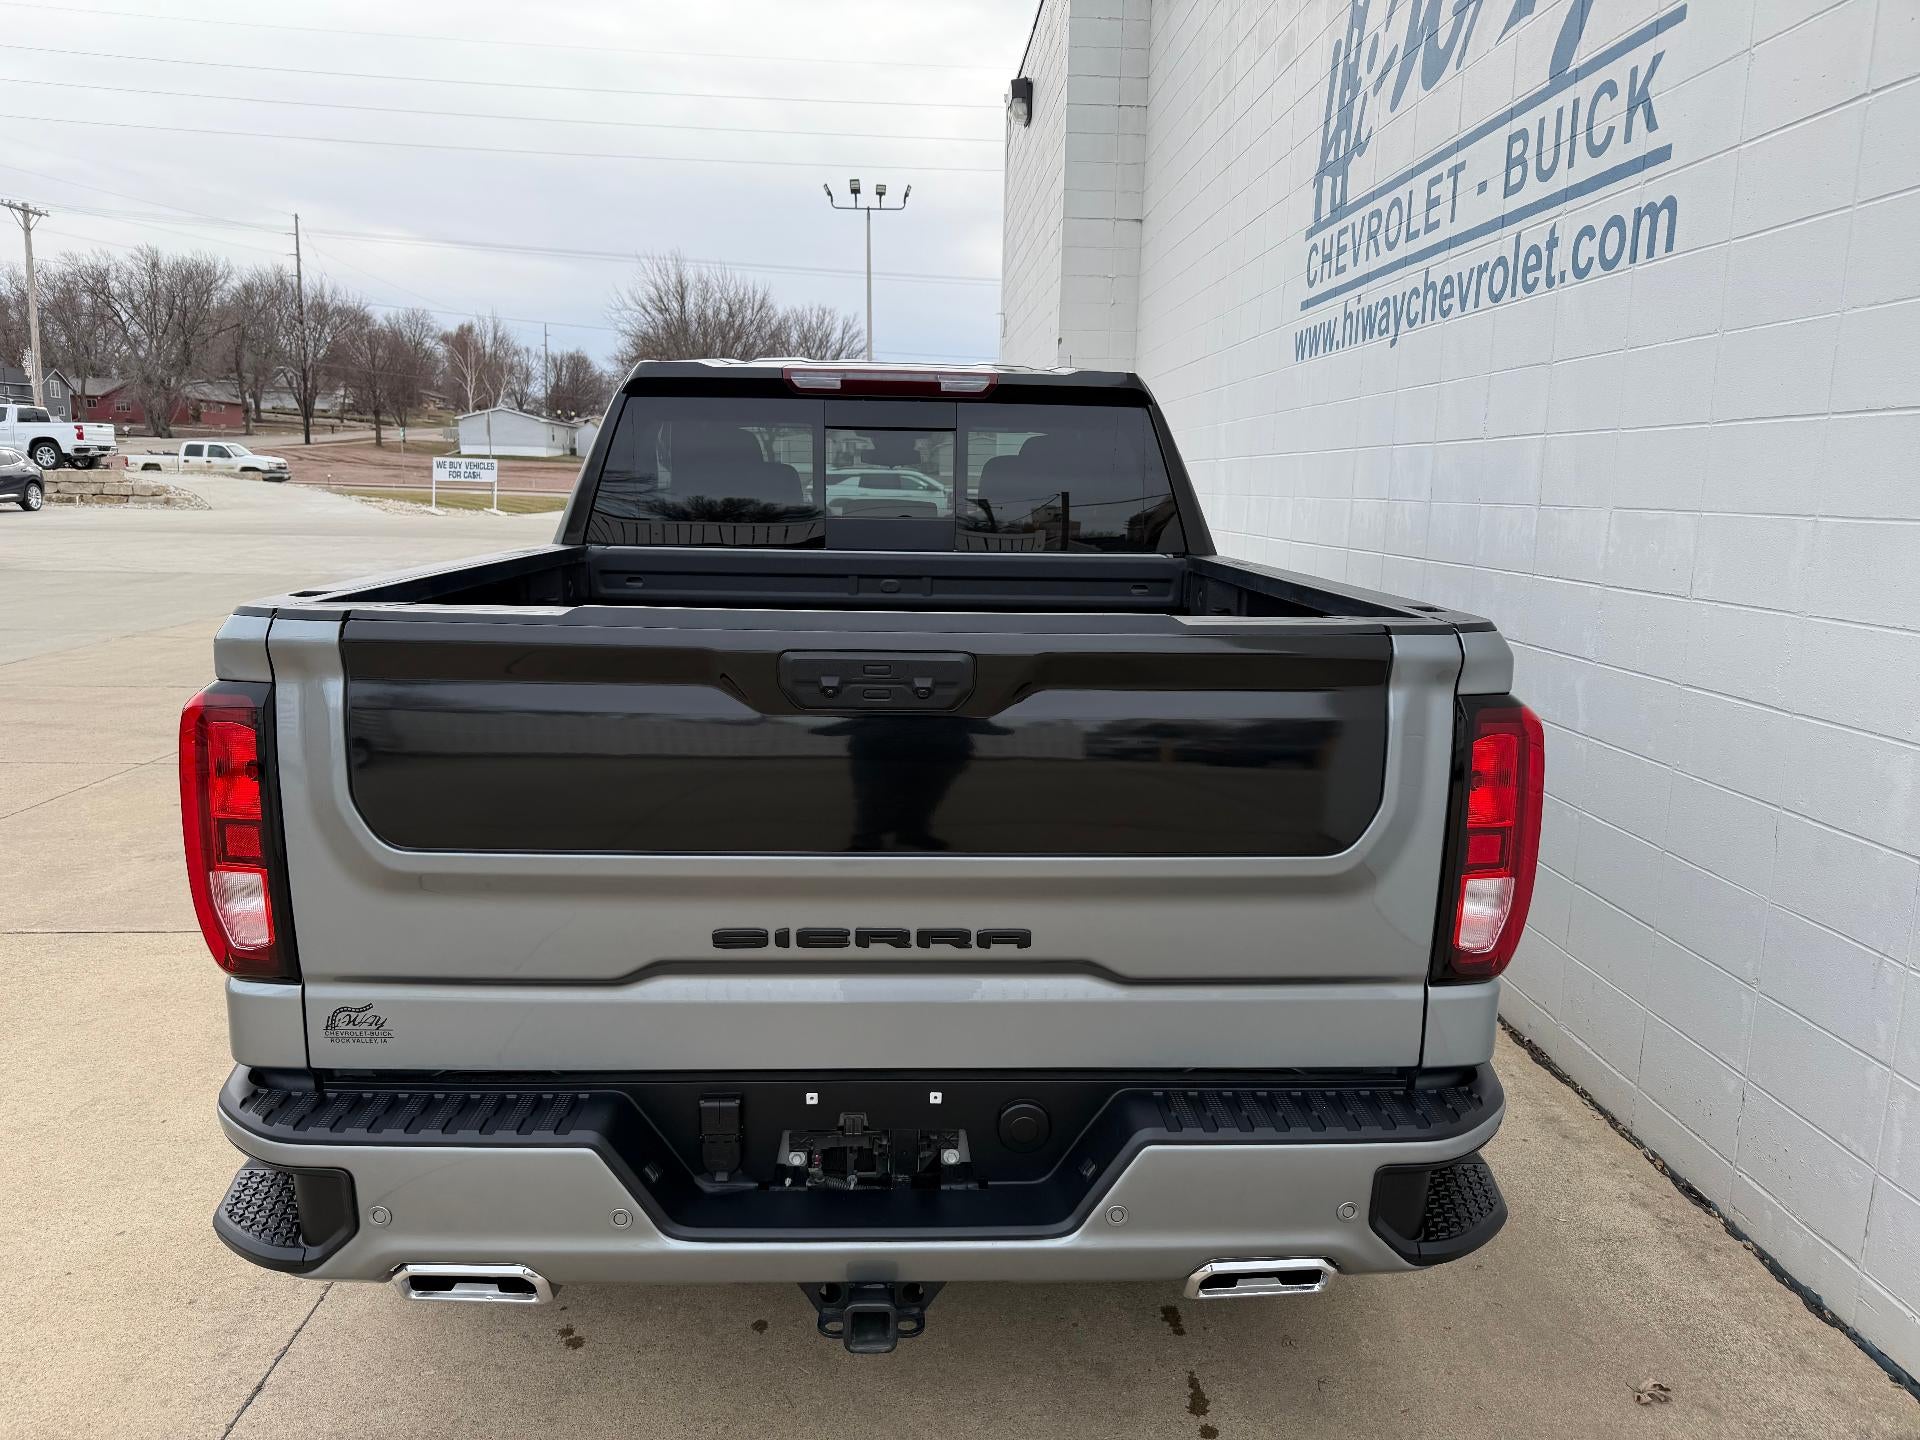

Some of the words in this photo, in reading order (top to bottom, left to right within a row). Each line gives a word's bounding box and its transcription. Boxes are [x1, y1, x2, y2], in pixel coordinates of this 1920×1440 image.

[1306, 159, 1466, 289] CHEVROLET
[1503, 49, 1666, 200] BUICK
[1294, 194, 1678, 363] www.hiwaychevrolet.com
[436, 461, 447, 469] WE
[449, 461, 462, 470] BUY
[465, 462, 495, 471] VEHICLES
[448, 471, 461, 479] FOR
[712, 927, 1032, 949] SIERRA
